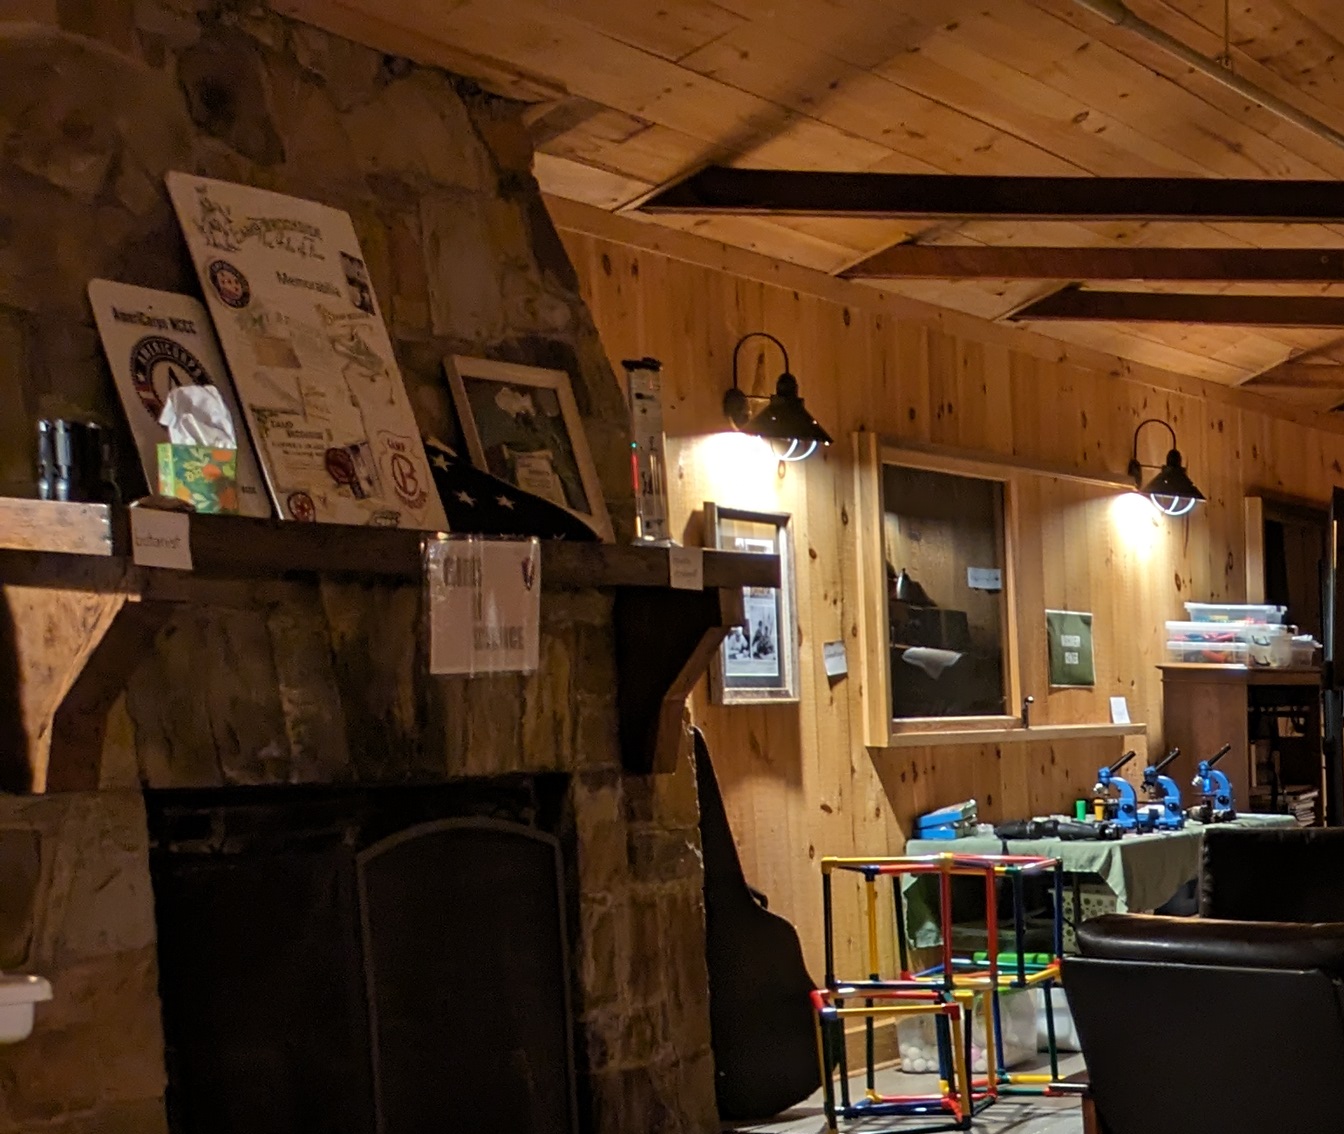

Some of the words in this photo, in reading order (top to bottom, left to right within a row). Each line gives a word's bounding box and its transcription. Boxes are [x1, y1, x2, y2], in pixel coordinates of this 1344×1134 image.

[276, 271, 341, 297] Memorabilia
[112, 306, 168, 330] AmeriCorps
[169, 317, 196, 334] NCCC
